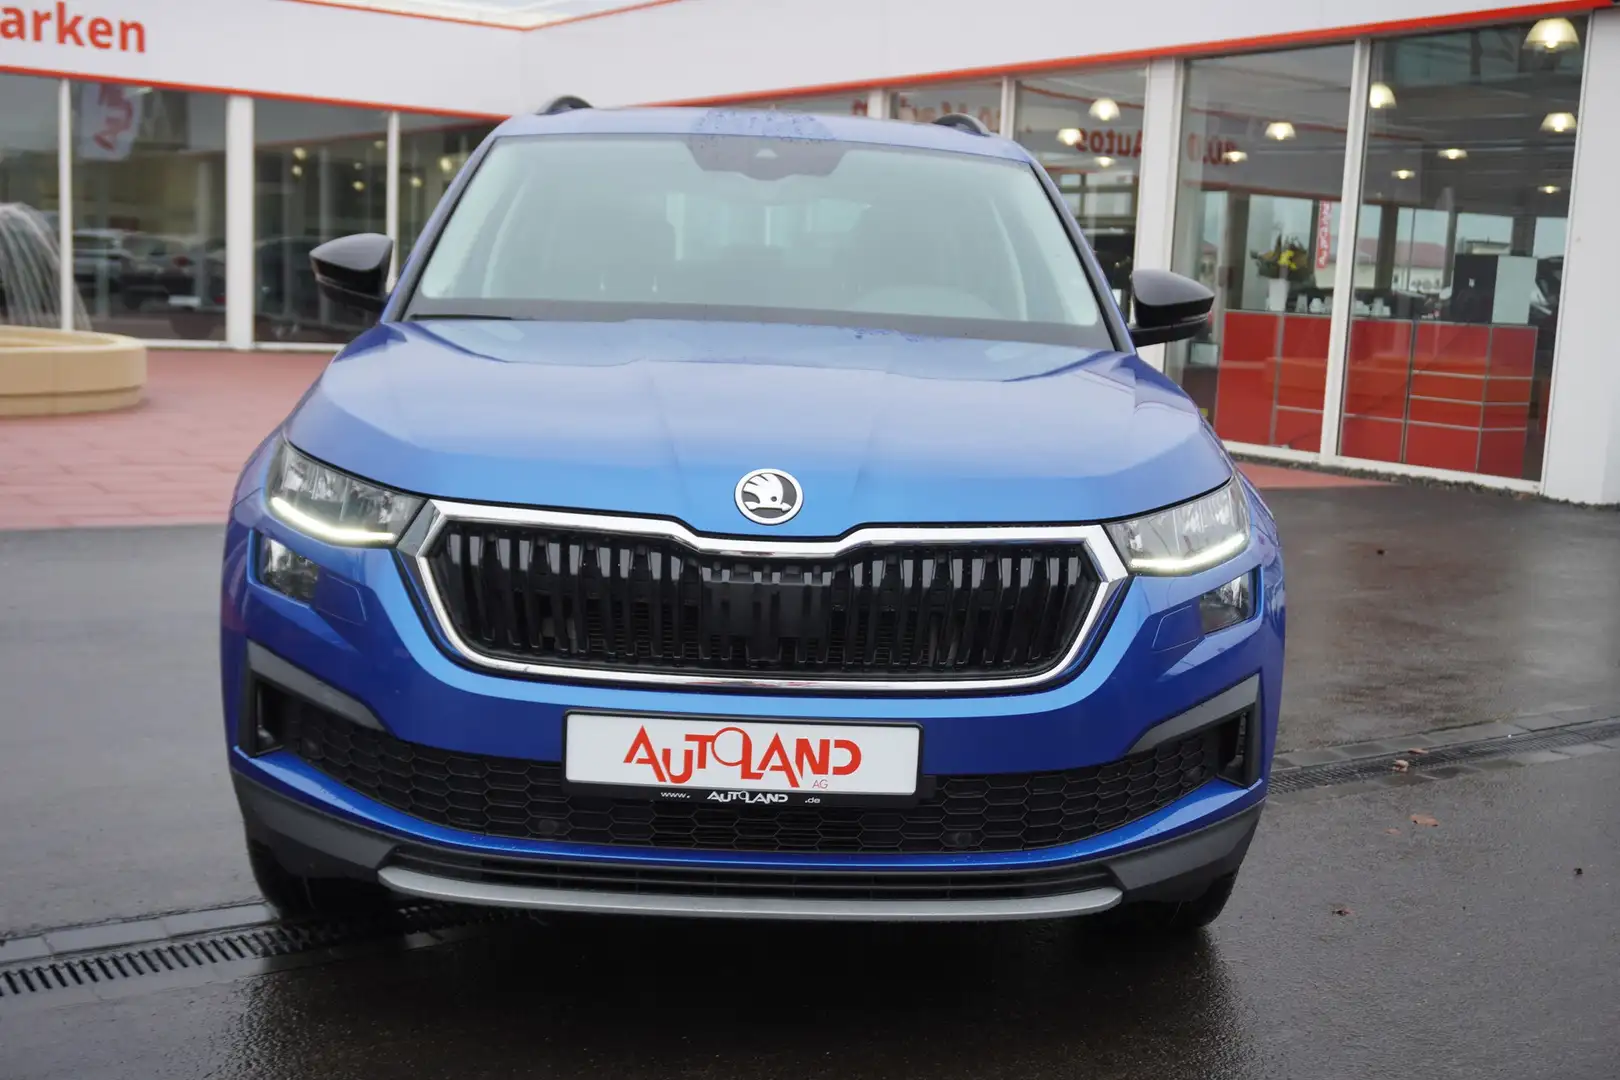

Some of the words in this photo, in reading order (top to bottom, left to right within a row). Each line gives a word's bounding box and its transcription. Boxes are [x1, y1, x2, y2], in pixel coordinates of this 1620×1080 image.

[623, 725, 862, 788] AUTOLAND
[811, 779, 829, 789] AG
[707, 790, 789, 804] AUTOLAND
[804, 796, 821, 804] .de
